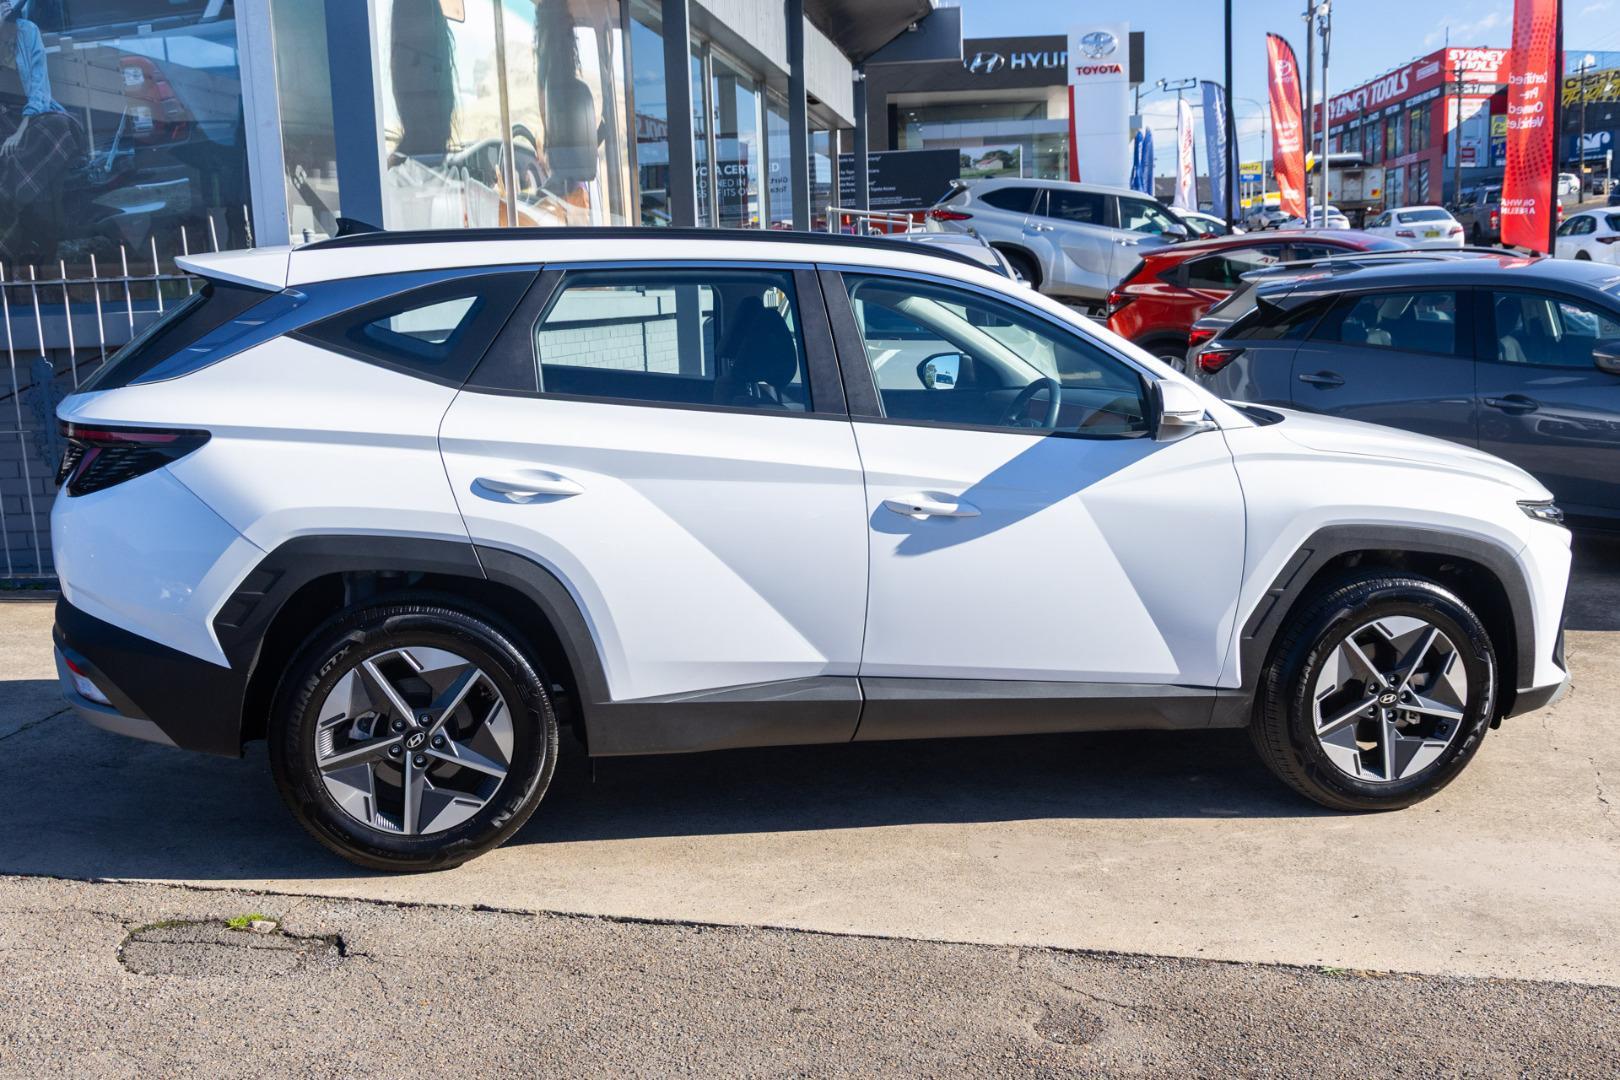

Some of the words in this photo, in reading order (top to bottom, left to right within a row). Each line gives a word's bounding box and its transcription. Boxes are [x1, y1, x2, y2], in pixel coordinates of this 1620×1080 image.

[1448, 50, 1507, 62] SYDNEY
[1076, 64, 1122, 76] TOYOTA
[1454, 60, 1501, 72] TOOLS
[1327, 86, 1370, 119] YDNEY
[1371, 66, 1413, 106] TOOLS
[320, 644, 351, 677] GTX
